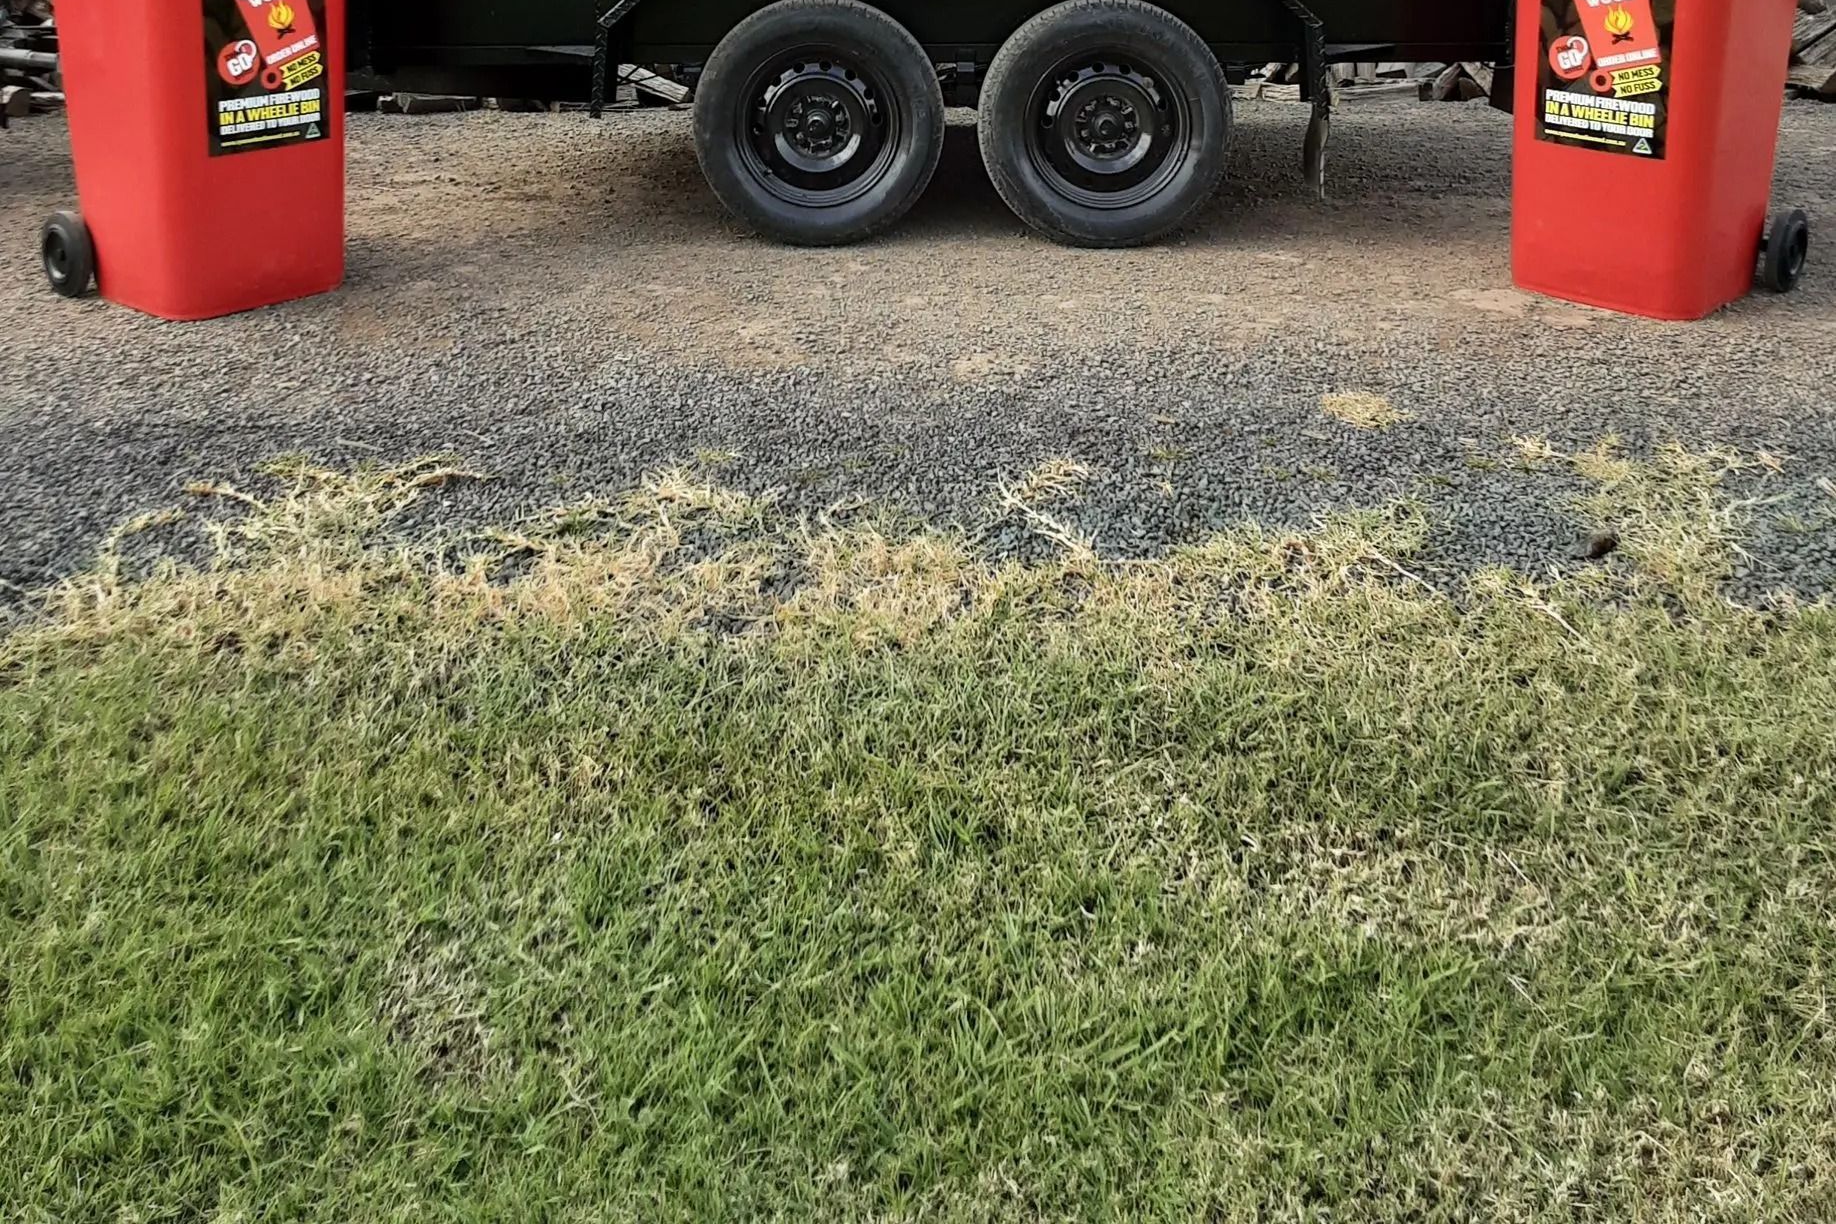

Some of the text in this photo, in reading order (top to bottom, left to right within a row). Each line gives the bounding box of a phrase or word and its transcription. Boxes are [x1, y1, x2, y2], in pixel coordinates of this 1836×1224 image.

[227, 53, 252, 76] GO
[1557, 49, 1582, 70] GO
[1618, 67, 1654, 80] NO MESS
[1620, 81, 1655, 94] NO FUSS
[218, 95, 269, 112] PREMIUM
[219, 99, 320, 125] IN A WHEELIE BIN
[1545, 89, 1656, 115] PREMIUM FIREWOOD
[1545, 100, 1655, 128] IN A WHEELIE BIN
